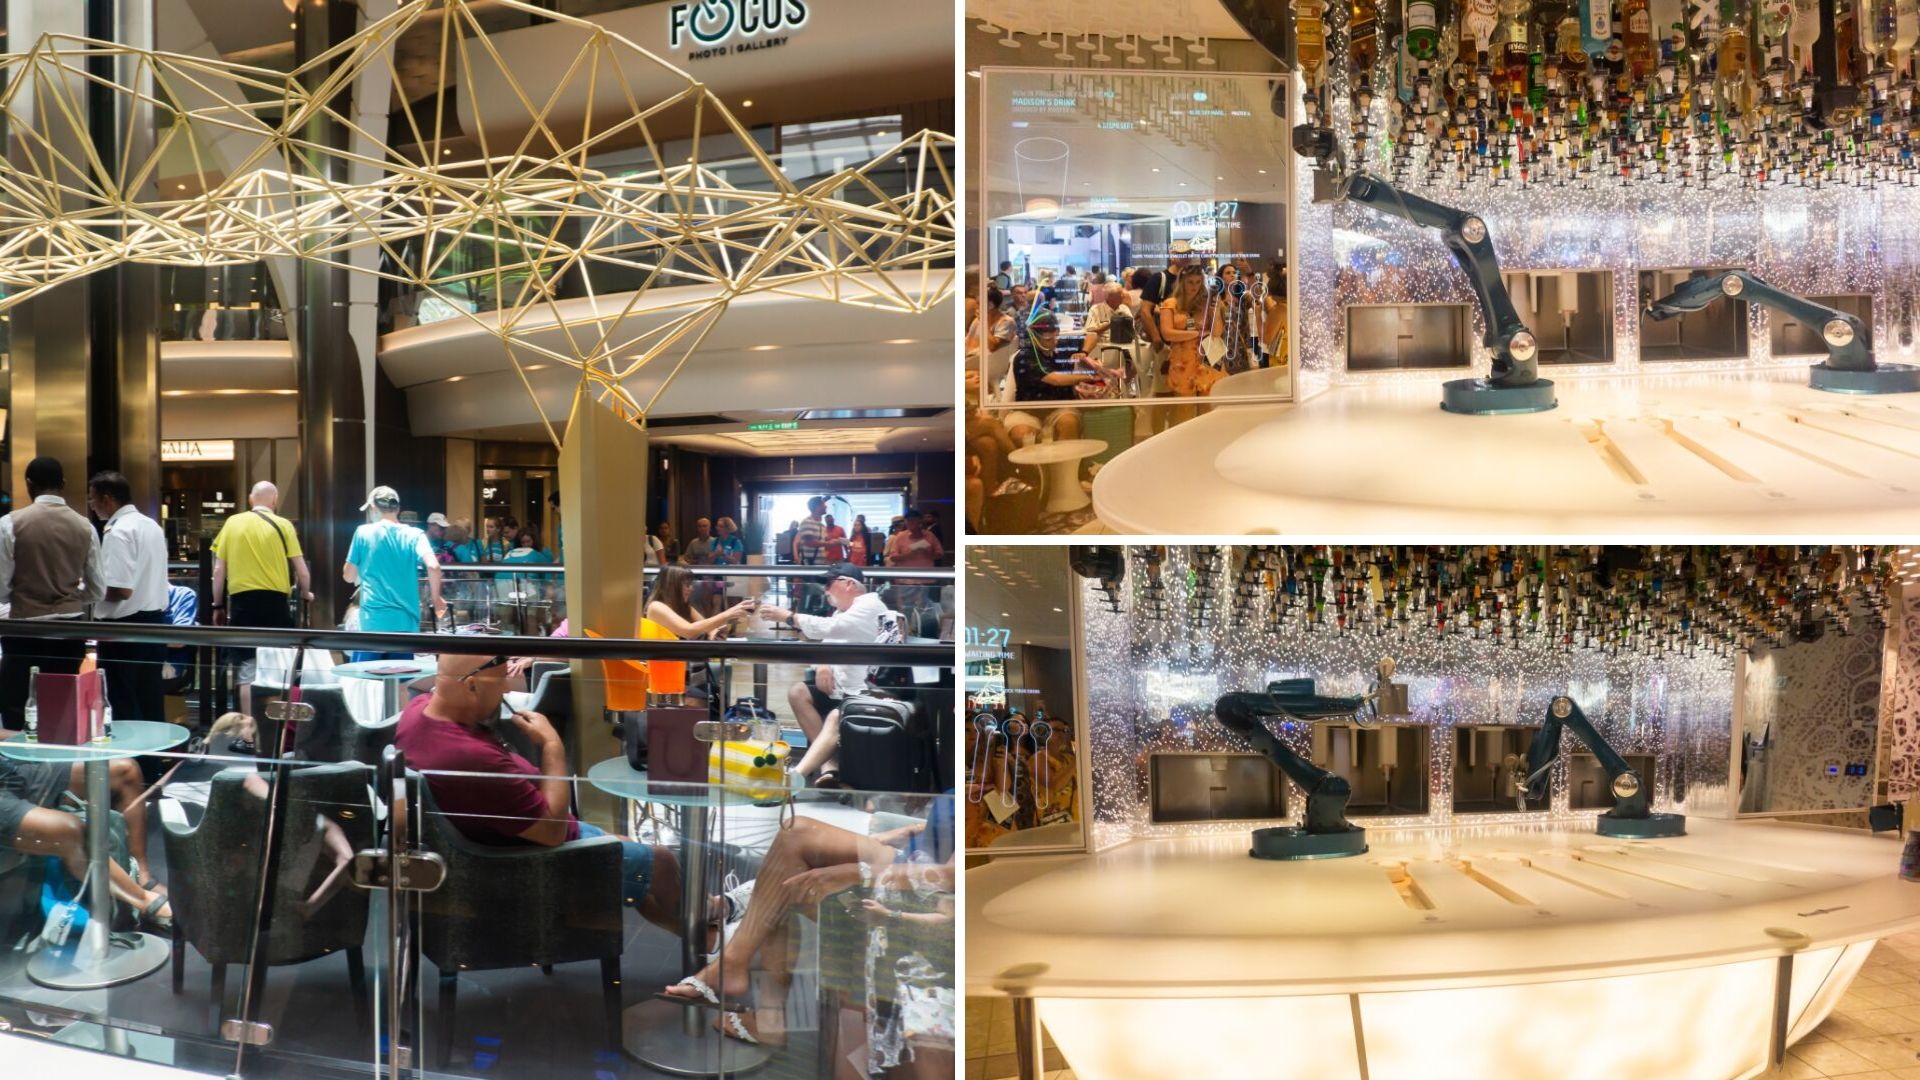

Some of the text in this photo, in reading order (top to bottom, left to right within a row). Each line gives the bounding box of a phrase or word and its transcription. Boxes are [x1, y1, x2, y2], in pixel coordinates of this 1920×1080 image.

[671, 0, 806, 45] FOCUS
[688, 37, 788, 61] PHOTO GALLERY
[1053, 98, 1076, 107] DRINK
[1197, 201, 1238, 219] 01:27
[1227, 221, 1241, 229] TIME
